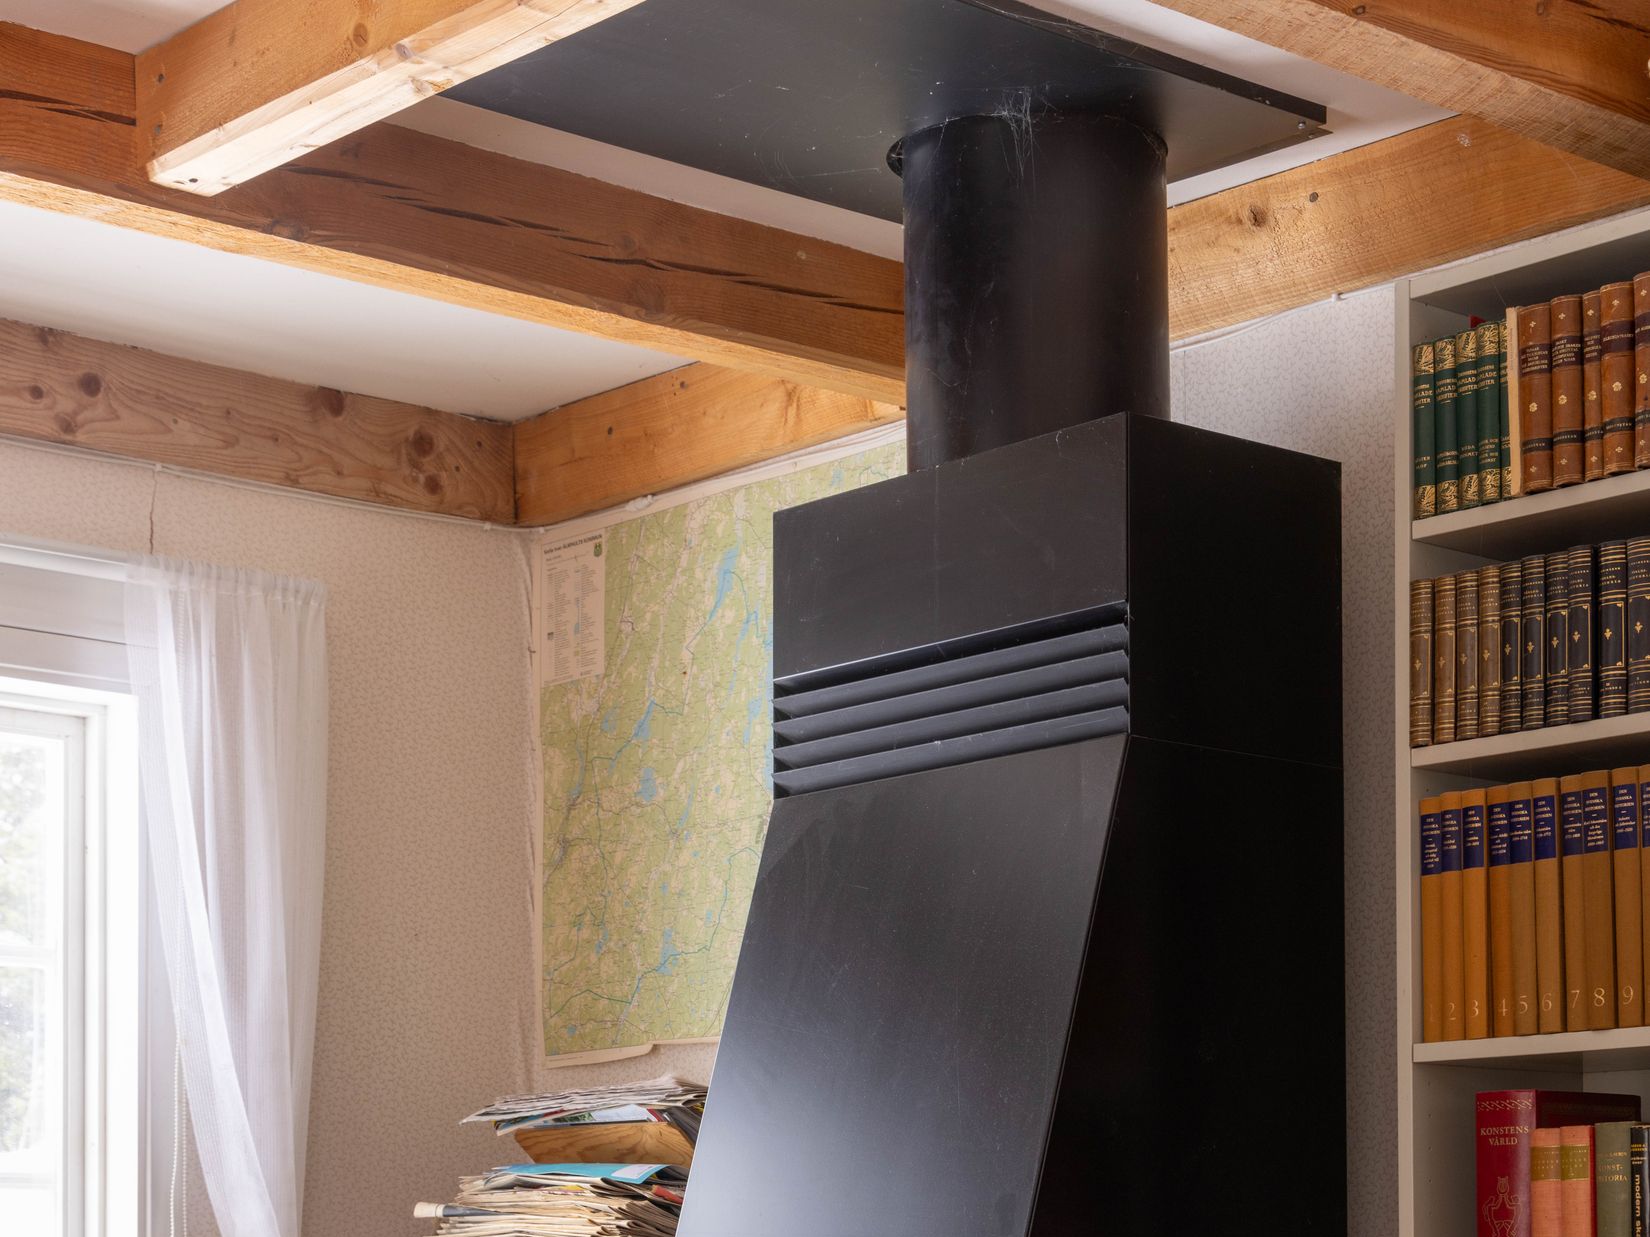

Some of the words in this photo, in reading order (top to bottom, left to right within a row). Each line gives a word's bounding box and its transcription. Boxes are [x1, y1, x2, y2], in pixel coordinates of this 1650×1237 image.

[1519, 995, 1528, 1014] 5
[1542, 992, 1552, 1011] 6
[1571, 990, 1580, 1008] 7
[1593, 987, 1605, 1006] 8
[1622, 985, 1634, 1005] 9
[1448, 1002, 1456, 1020] 2
[1471, 1000, 1479, 1017] 3
[1499, 998, 1508, 1017] 4
[1480, 1126, 1530, 1136] KONSTENS
